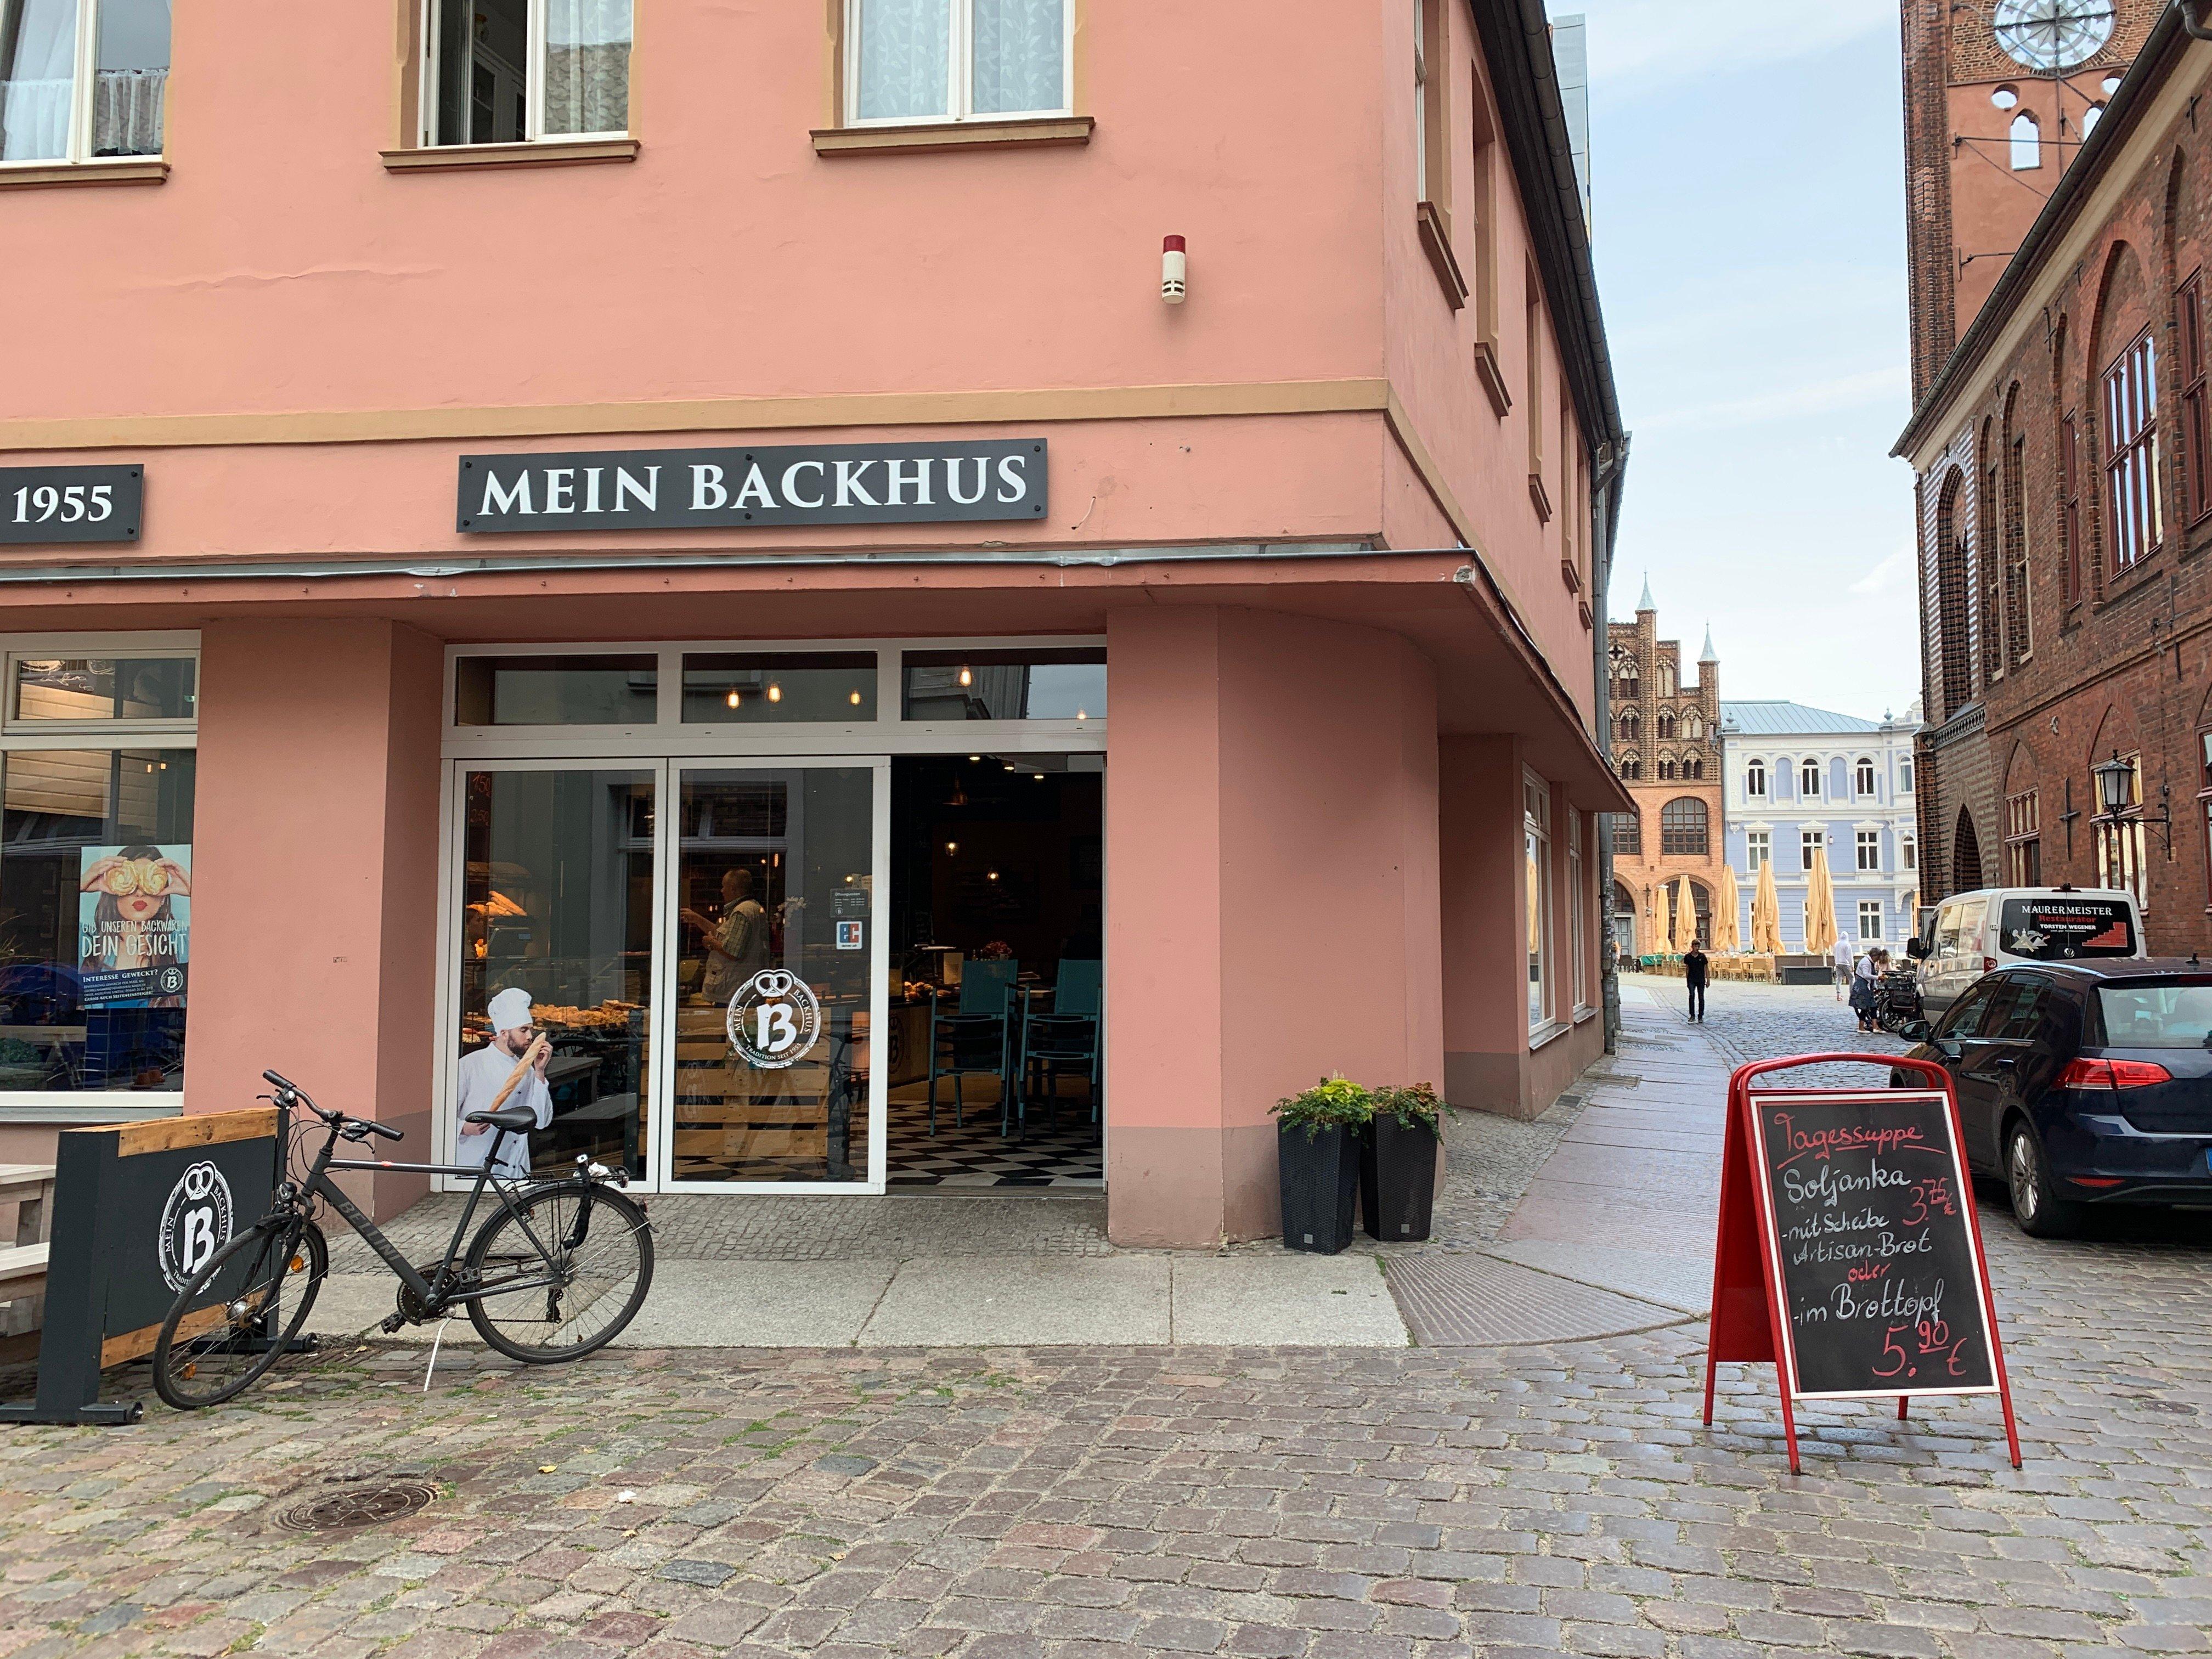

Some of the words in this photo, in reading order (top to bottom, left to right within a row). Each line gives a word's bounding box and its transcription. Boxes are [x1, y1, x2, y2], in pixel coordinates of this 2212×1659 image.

[476, 465, 662, 516] MEIN
[689, 454, 1026, 511] BACKHUS
[11, 486, 112, 523] 1955
[82, 922, 97, 933] GIB
[101, 920, 137, 933] UNSEREN
[141, 918, 188, 932] BACKWAREN
[2022, 905, 2113, 916] MAURERMEISTER
[82, 935, 119, 958] DEIN
[126, 933, 187, 956] GESICHT
[83, 974, 119, 983] INTERESSE
[122, 969, 158, 979] GEWECKT?
[733, 1005, 743, 1031] MEIN
[757, 1003, 797, 1052] B
[793, 989, 812, 1033] BACKHUS
[746, 1044, 776, 1060] TRADITION
[777, 1051, 789, 1059] SEIT
[789, 1042, 802, 1054] 1955
[1774, 1113, 1924, 1160] Tagessuppe
[1784, 1158, 1912, 1207] Soljanka
[213, 1185, 228, 1241] BACKHUS
[338, 1201, 402, 1261] BELLINI
[1823, 1207, 1890, 1234] Scheibe
[165, 1217, 174, 1252] MEIN
[183, 1206, 215, 1274] B
[1793, 1227, 1932, 1266] Artisan-Brot
[173, 1269, 190, 1285] TRADIT
[1848, 1259, 1892, 1283] oder
[1830, 1278, 1945, 1329] Brottopf
[1946, 1337, 1968, 1376] €
